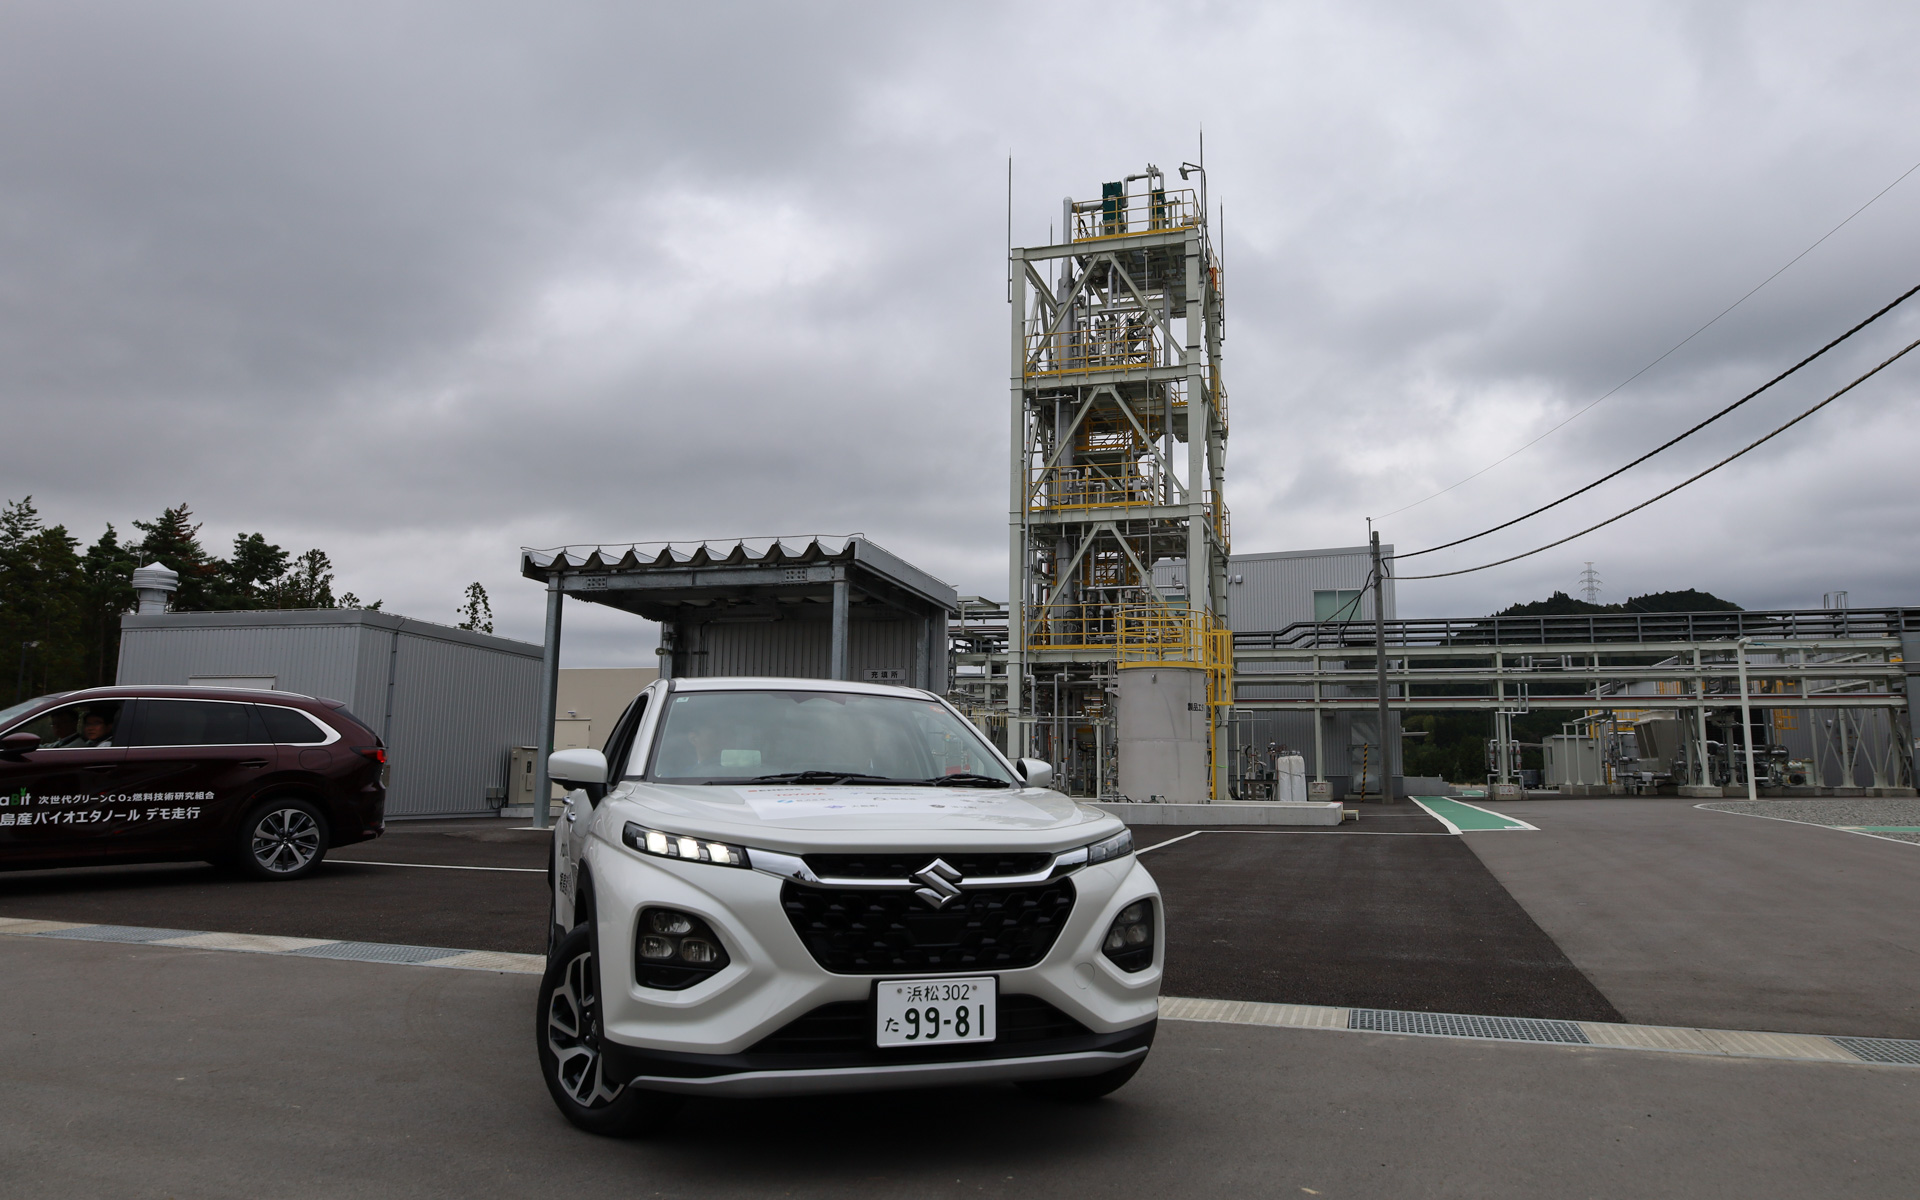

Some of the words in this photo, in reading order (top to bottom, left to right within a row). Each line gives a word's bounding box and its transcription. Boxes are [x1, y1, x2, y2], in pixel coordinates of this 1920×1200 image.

[871, 671, 898, 679] 充填所
[146, 806, 201, 821] デモ走行
[885, 1017, 900, 1033] た
[905, 1004, 985, 1040] 99-81
